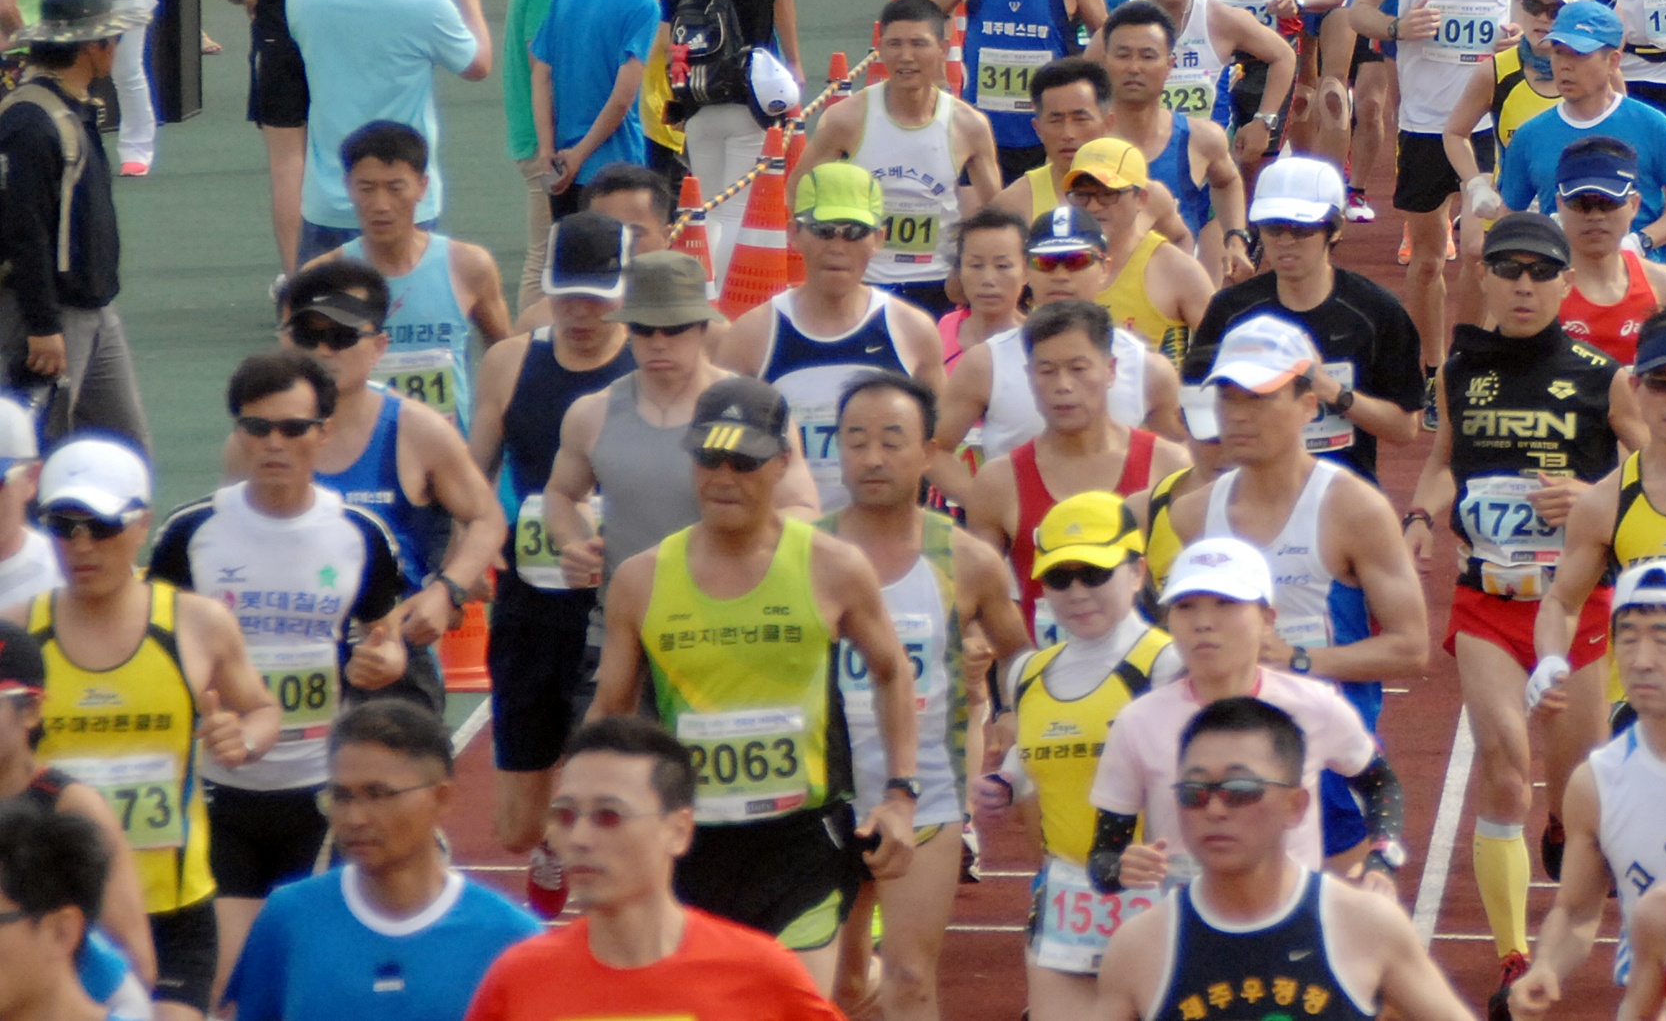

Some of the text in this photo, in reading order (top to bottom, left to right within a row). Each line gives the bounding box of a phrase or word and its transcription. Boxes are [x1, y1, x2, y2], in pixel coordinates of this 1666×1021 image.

[980, 64, 1030, 91] 311
[1473, 440, 1512, 450] INSPIRED
[1530, 441, 1559, 450] WATER
[763, 605, 790, 616] CRC
[690, 737, 799, 786] 2063
